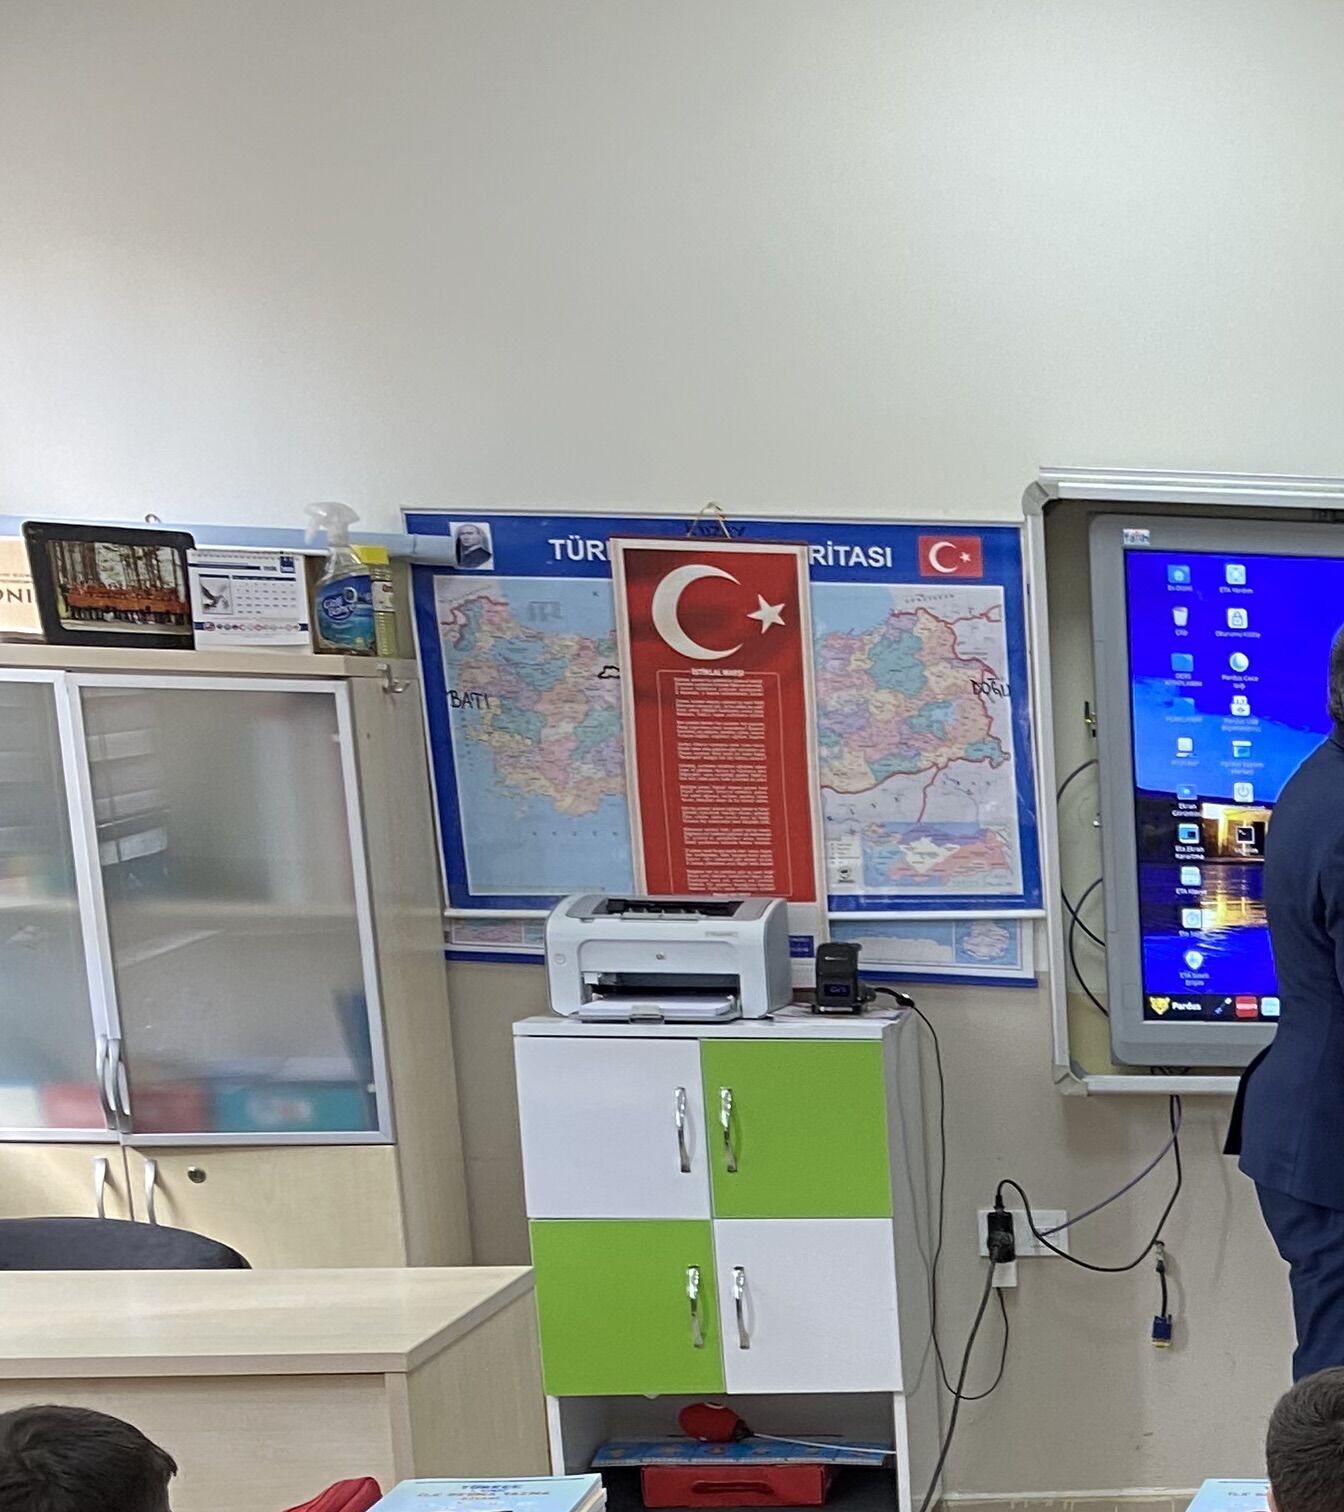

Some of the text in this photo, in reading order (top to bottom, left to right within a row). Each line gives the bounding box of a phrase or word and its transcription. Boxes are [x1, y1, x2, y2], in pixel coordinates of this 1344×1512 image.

[970, 677, 1011, 699] DOĞU
[447, 689, 490, 710] BATI
[1172, 1002, 1201, 1011] Pardus
